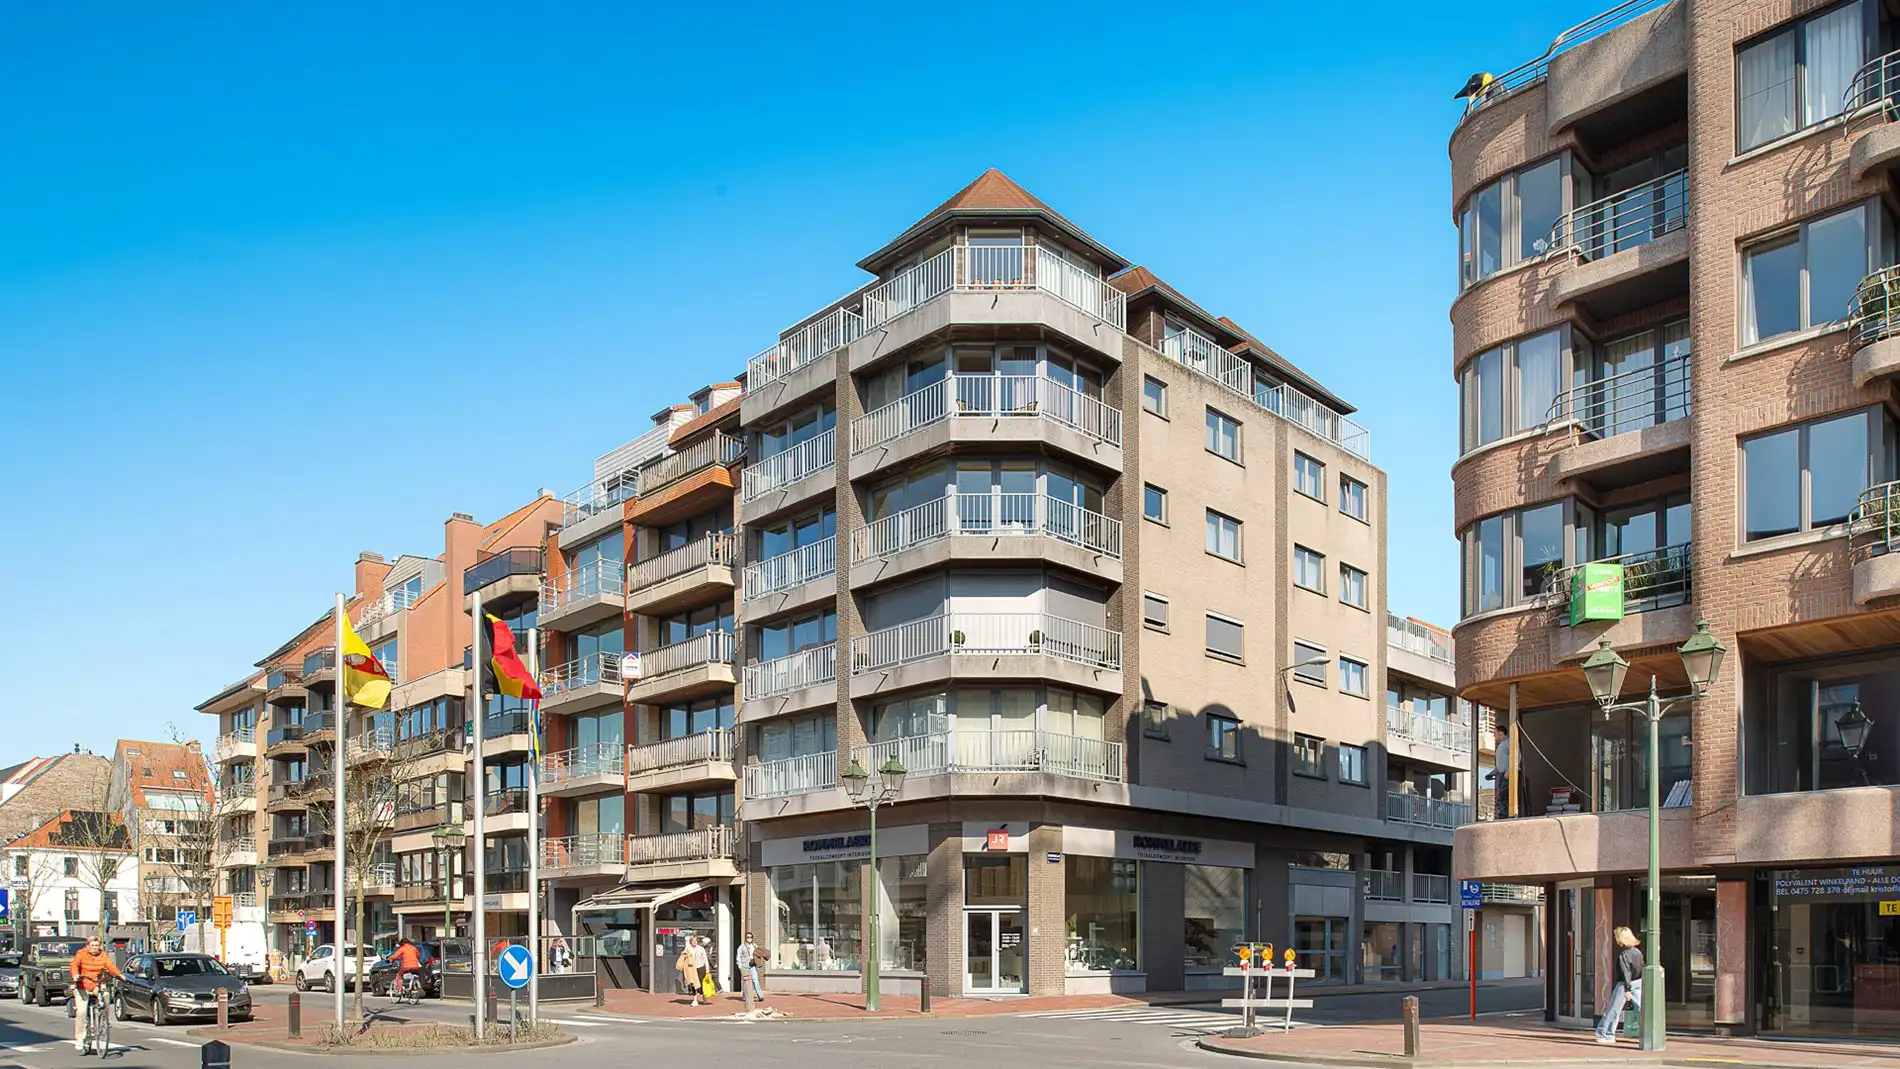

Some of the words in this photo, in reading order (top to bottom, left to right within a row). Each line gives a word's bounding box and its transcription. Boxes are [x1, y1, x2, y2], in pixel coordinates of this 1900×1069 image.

[992, 834, 1005, 844] JR
[1820, 878, 1865, 886] WINKELPAND
[1776, 888, 1788, 896] BEL
[1790, 887, 1809, 895] 0475
[1811, 886, 1824, 894] 728
[1826, 886, 1840, 894] 378
[1886, 904, 1897, 912] TE
